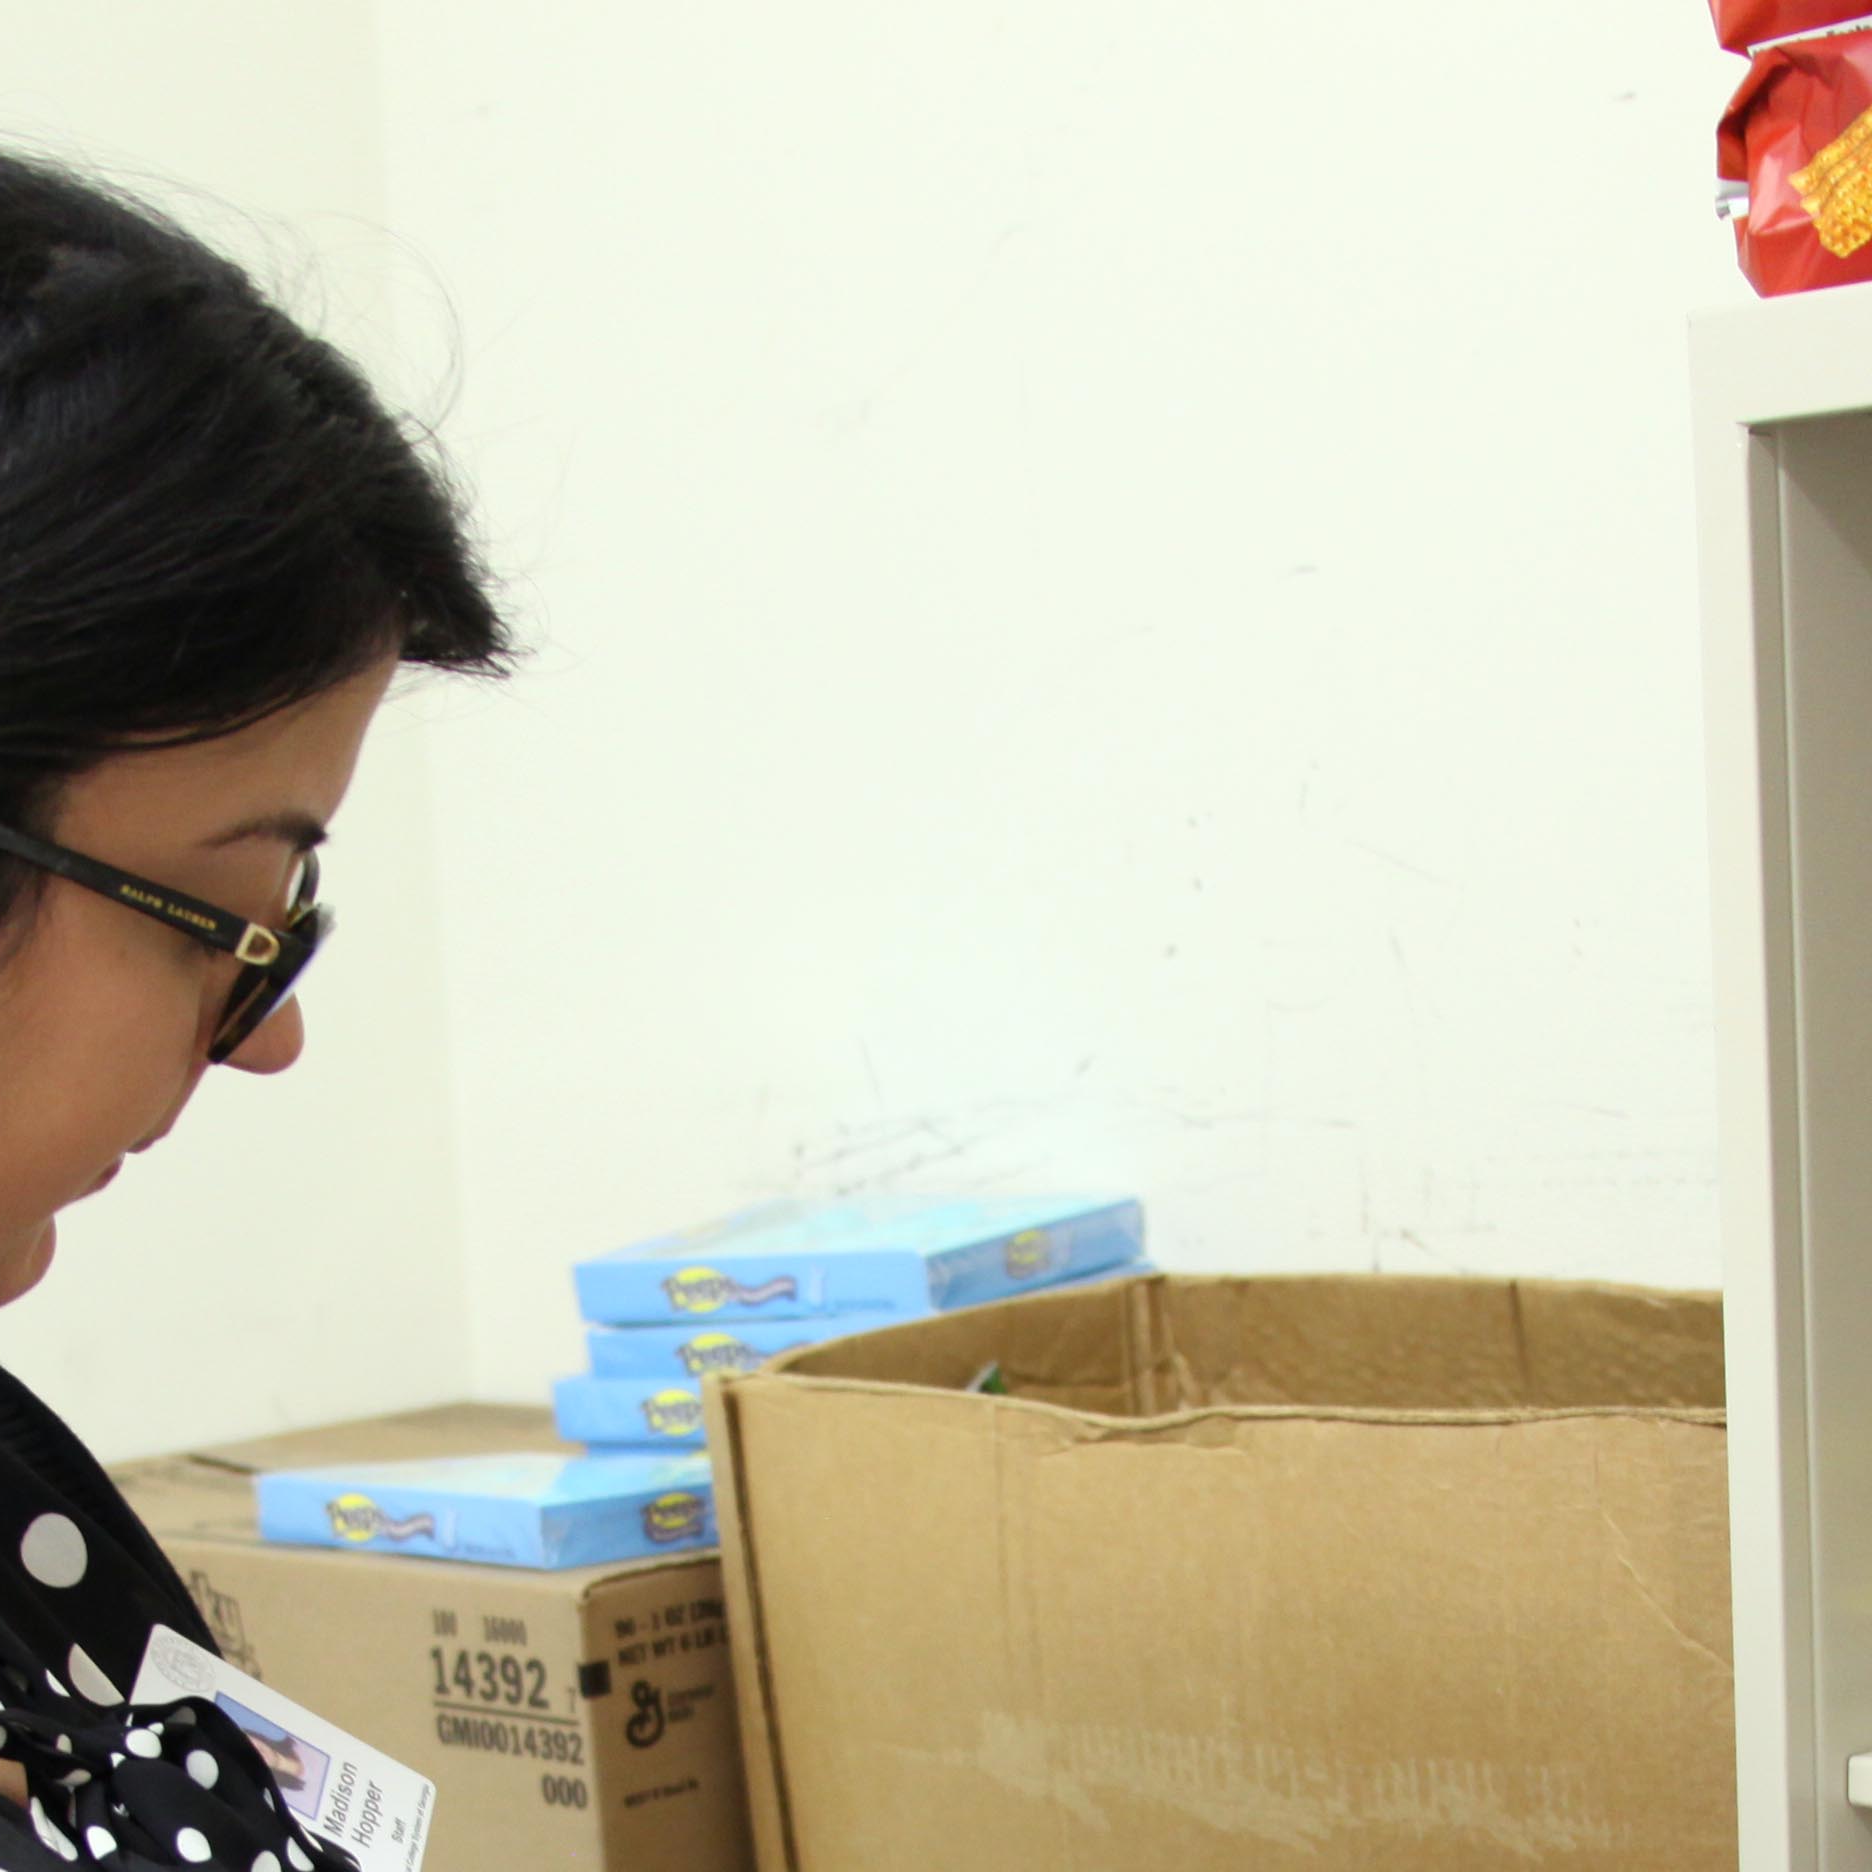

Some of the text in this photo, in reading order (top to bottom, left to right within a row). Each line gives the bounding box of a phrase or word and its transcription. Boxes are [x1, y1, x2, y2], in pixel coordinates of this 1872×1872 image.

[119, 884, 217, 931] RALPH LAUREN
[431, 1648, 549, 1710] 14392
[436, 1713, 584, 1766] GMI0014392
[323, 1761, 358, 1839] Madison
[351, 1779, 384, 1849] Hopper
[541, 1774, 588, 1810] 000
